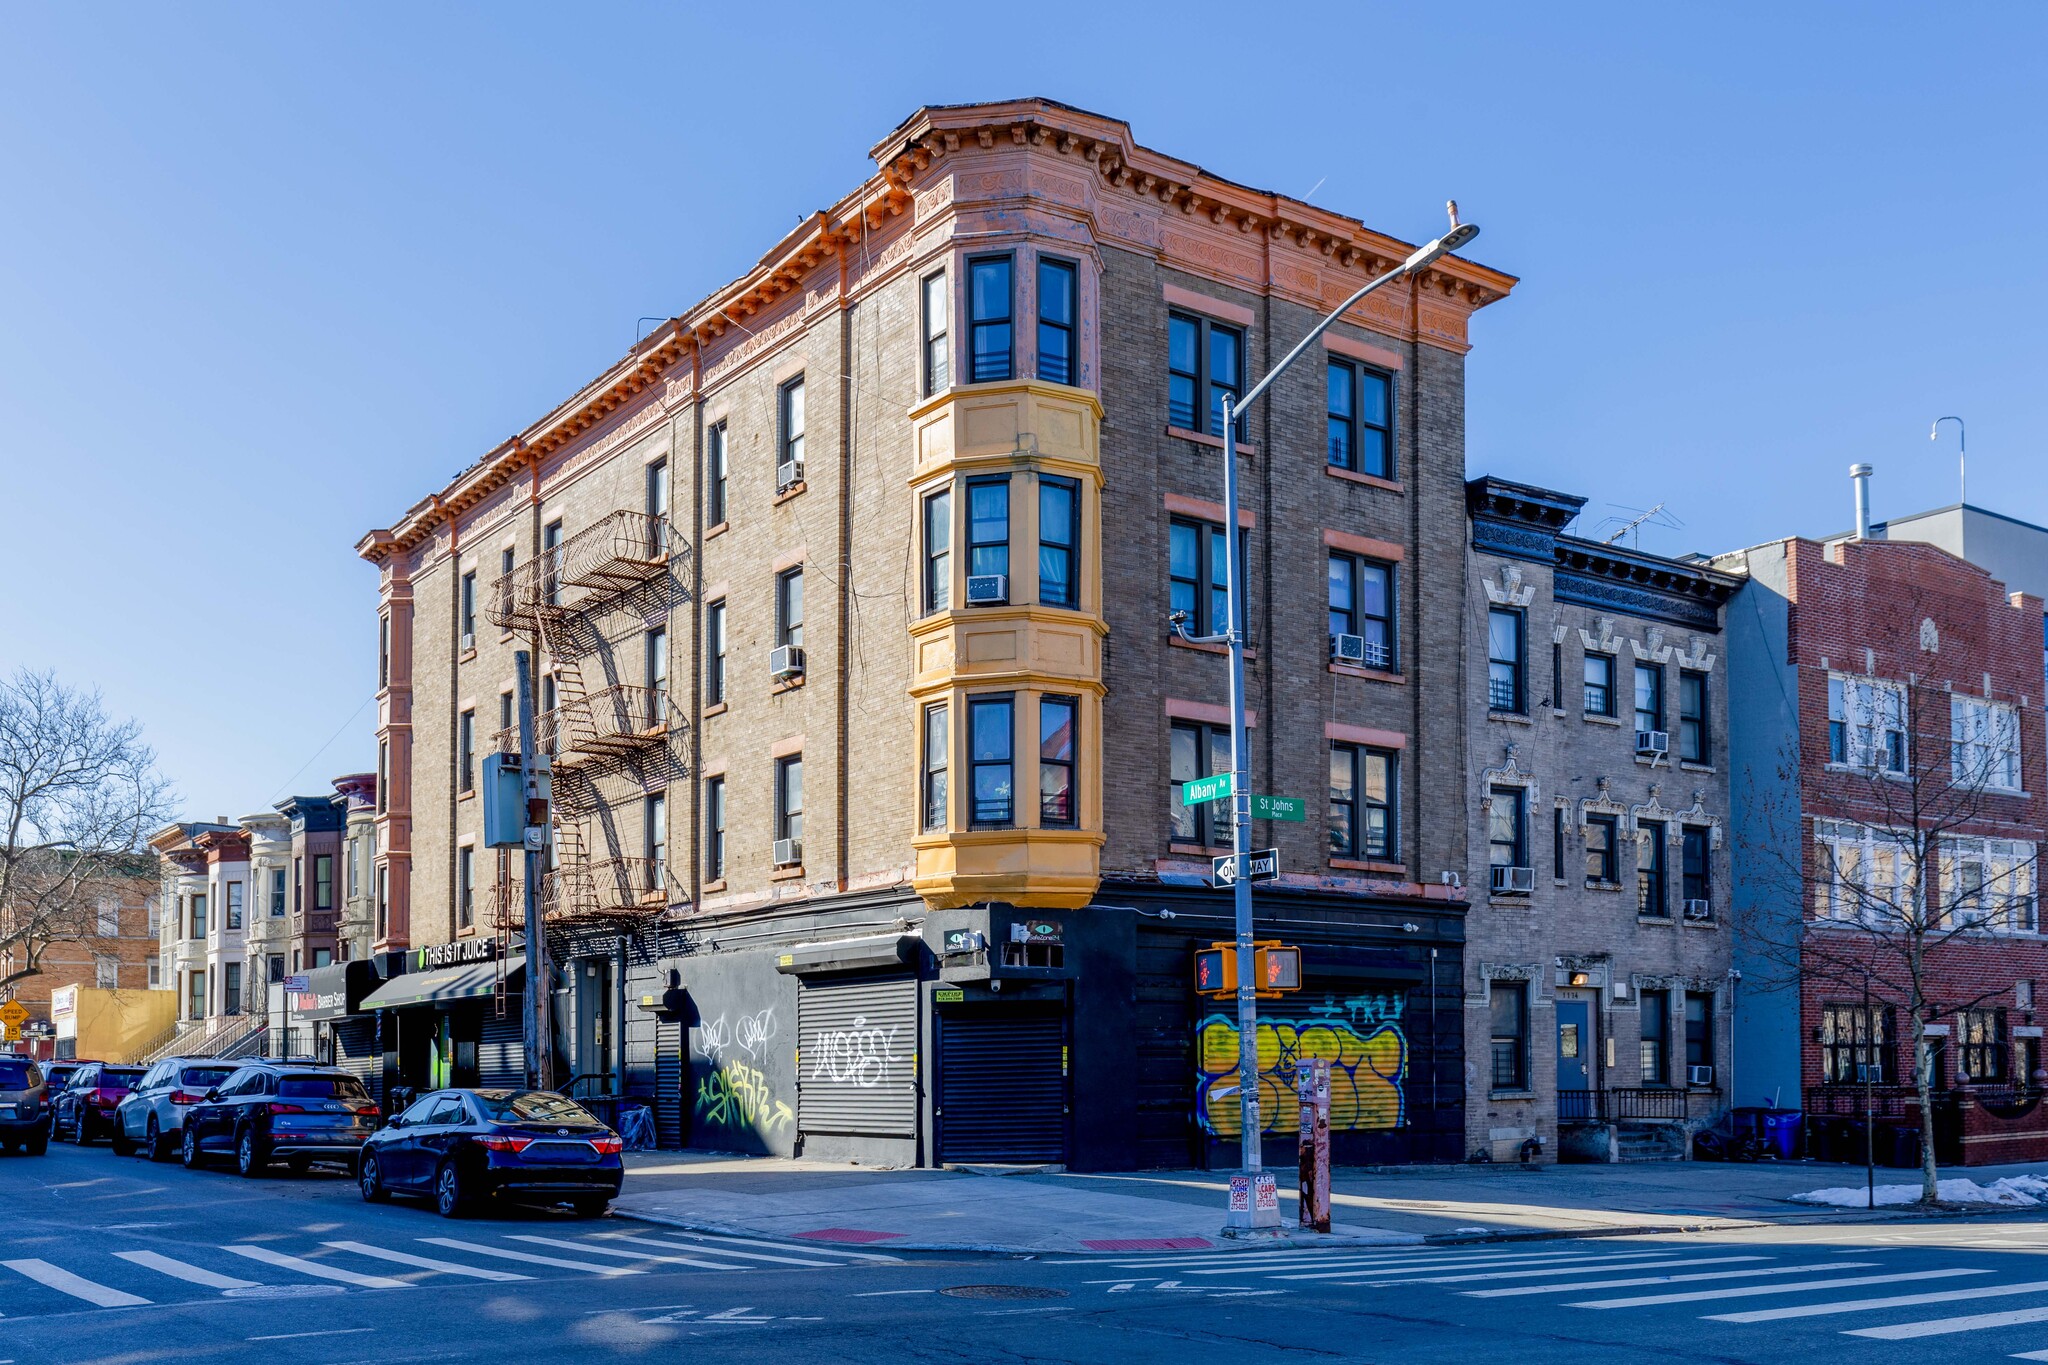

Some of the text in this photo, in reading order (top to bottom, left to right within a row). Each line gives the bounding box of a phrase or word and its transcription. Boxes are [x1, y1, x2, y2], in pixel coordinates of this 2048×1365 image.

[1190, 783, 1216, 800] Albany
[1260, 798, 1293, 811] St Johns
[1223, 859, 1269, 877] ON WAY
[425, 939, 488, 966] THIS IS IT JUICE
[946, 943, 961, 951] SafeZon
[317, 994, 333, 1009] BARBER
[333, 992, 345, 1007] SHOP
[1255, 1176, 1274, 1184] CASH
[1261, 1184, 1275, 1192] CARS
